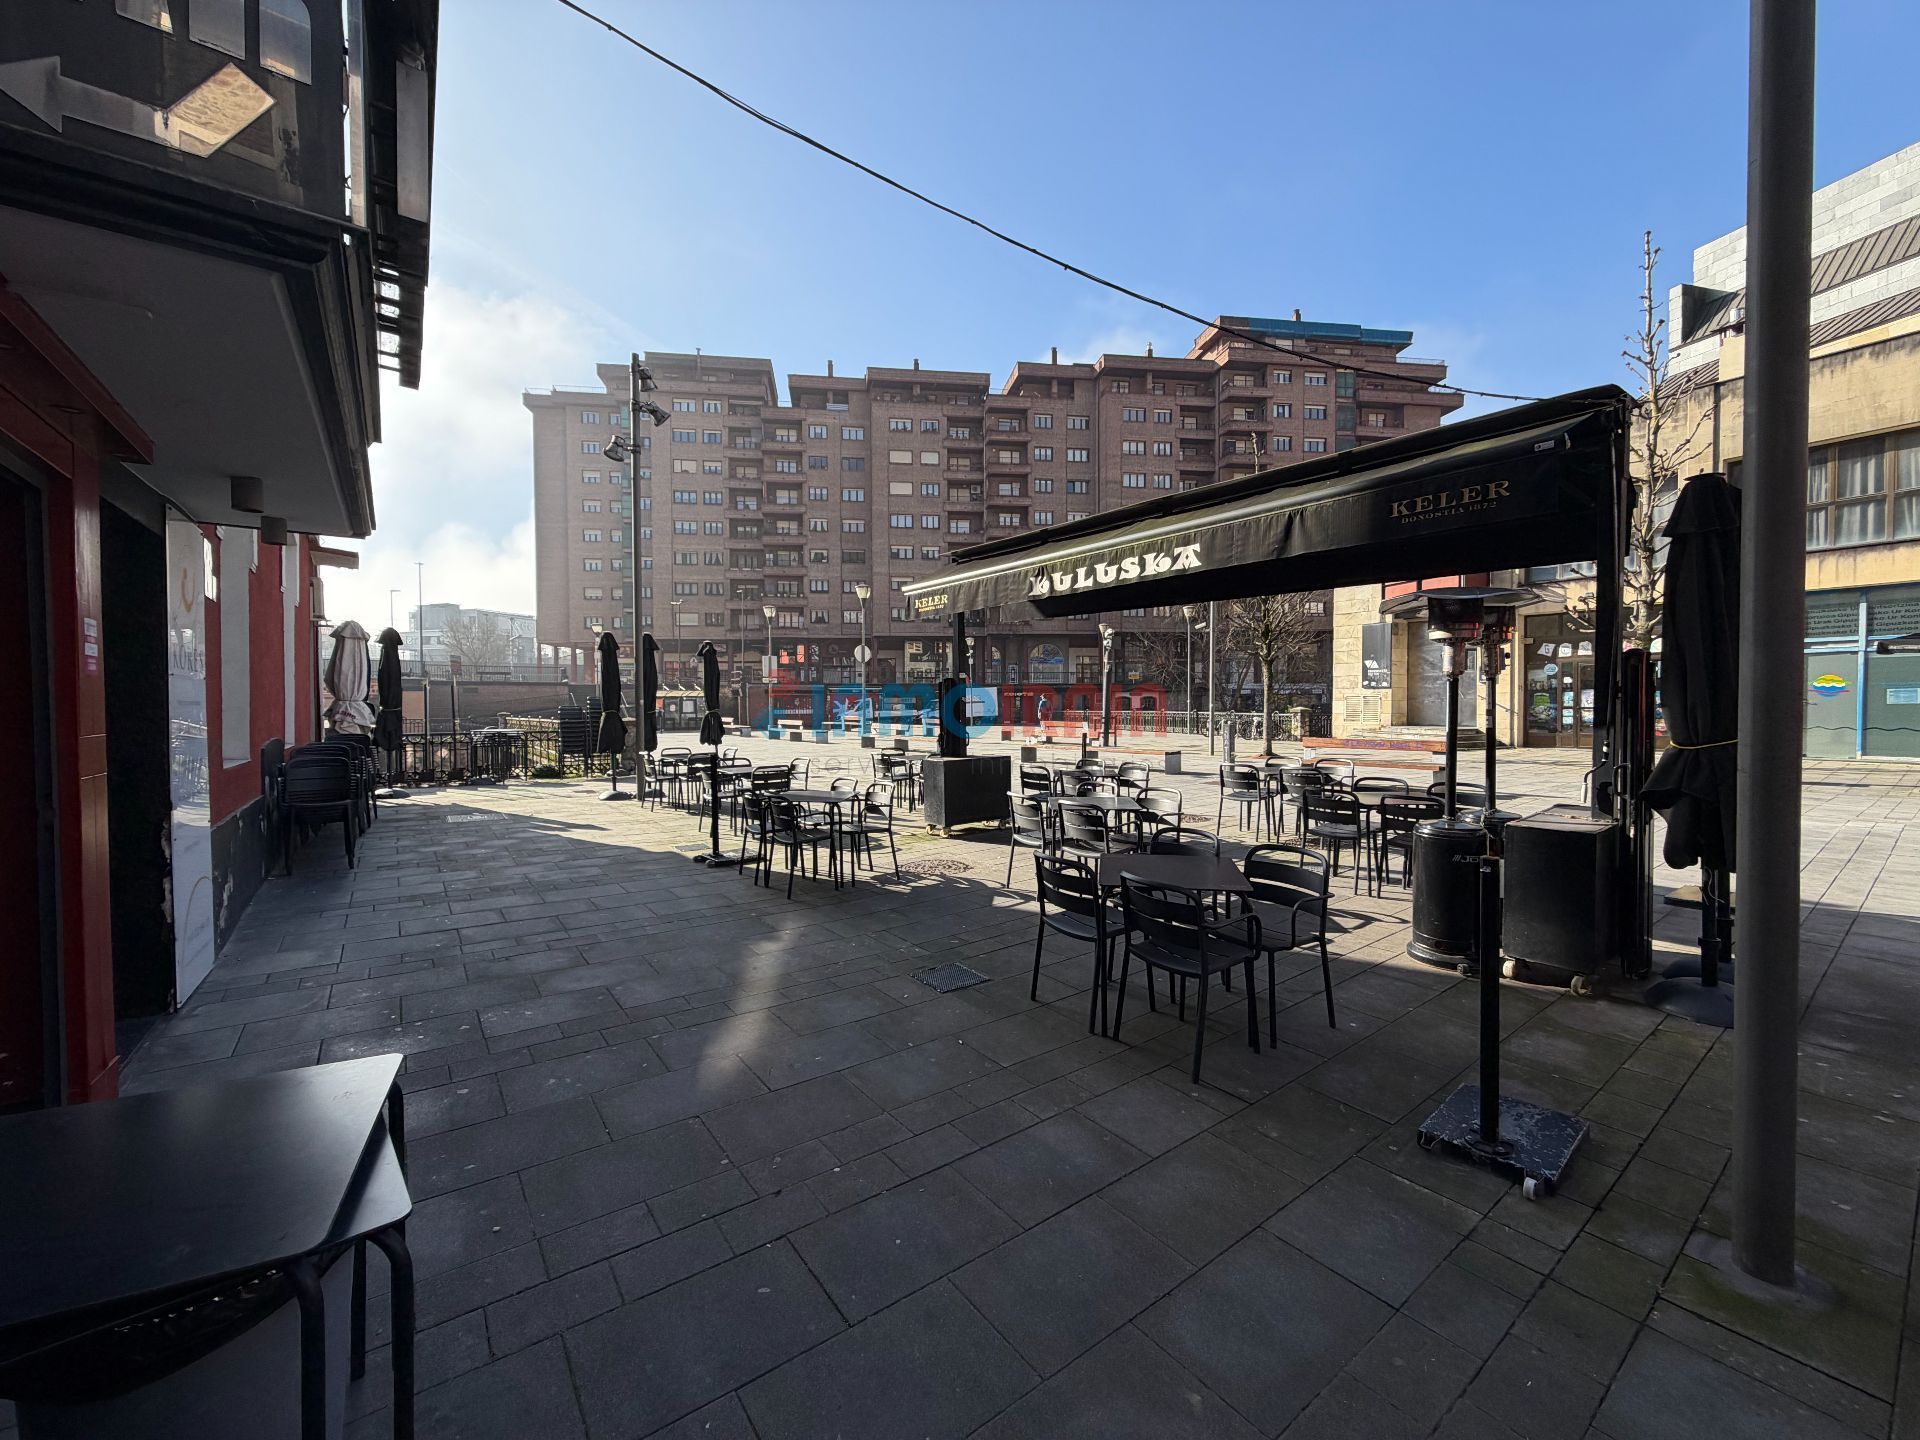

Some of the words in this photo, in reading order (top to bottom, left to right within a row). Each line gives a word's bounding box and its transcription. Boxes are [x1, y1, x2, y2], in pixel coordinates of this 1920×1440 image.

[1390, 480, 1511, 517] KELER
[1401, 506, 1464, 524] DONOSTIA
[1028, 543, 1202, 596] KULUSKA
[914, 594, 949, 609] KELER
